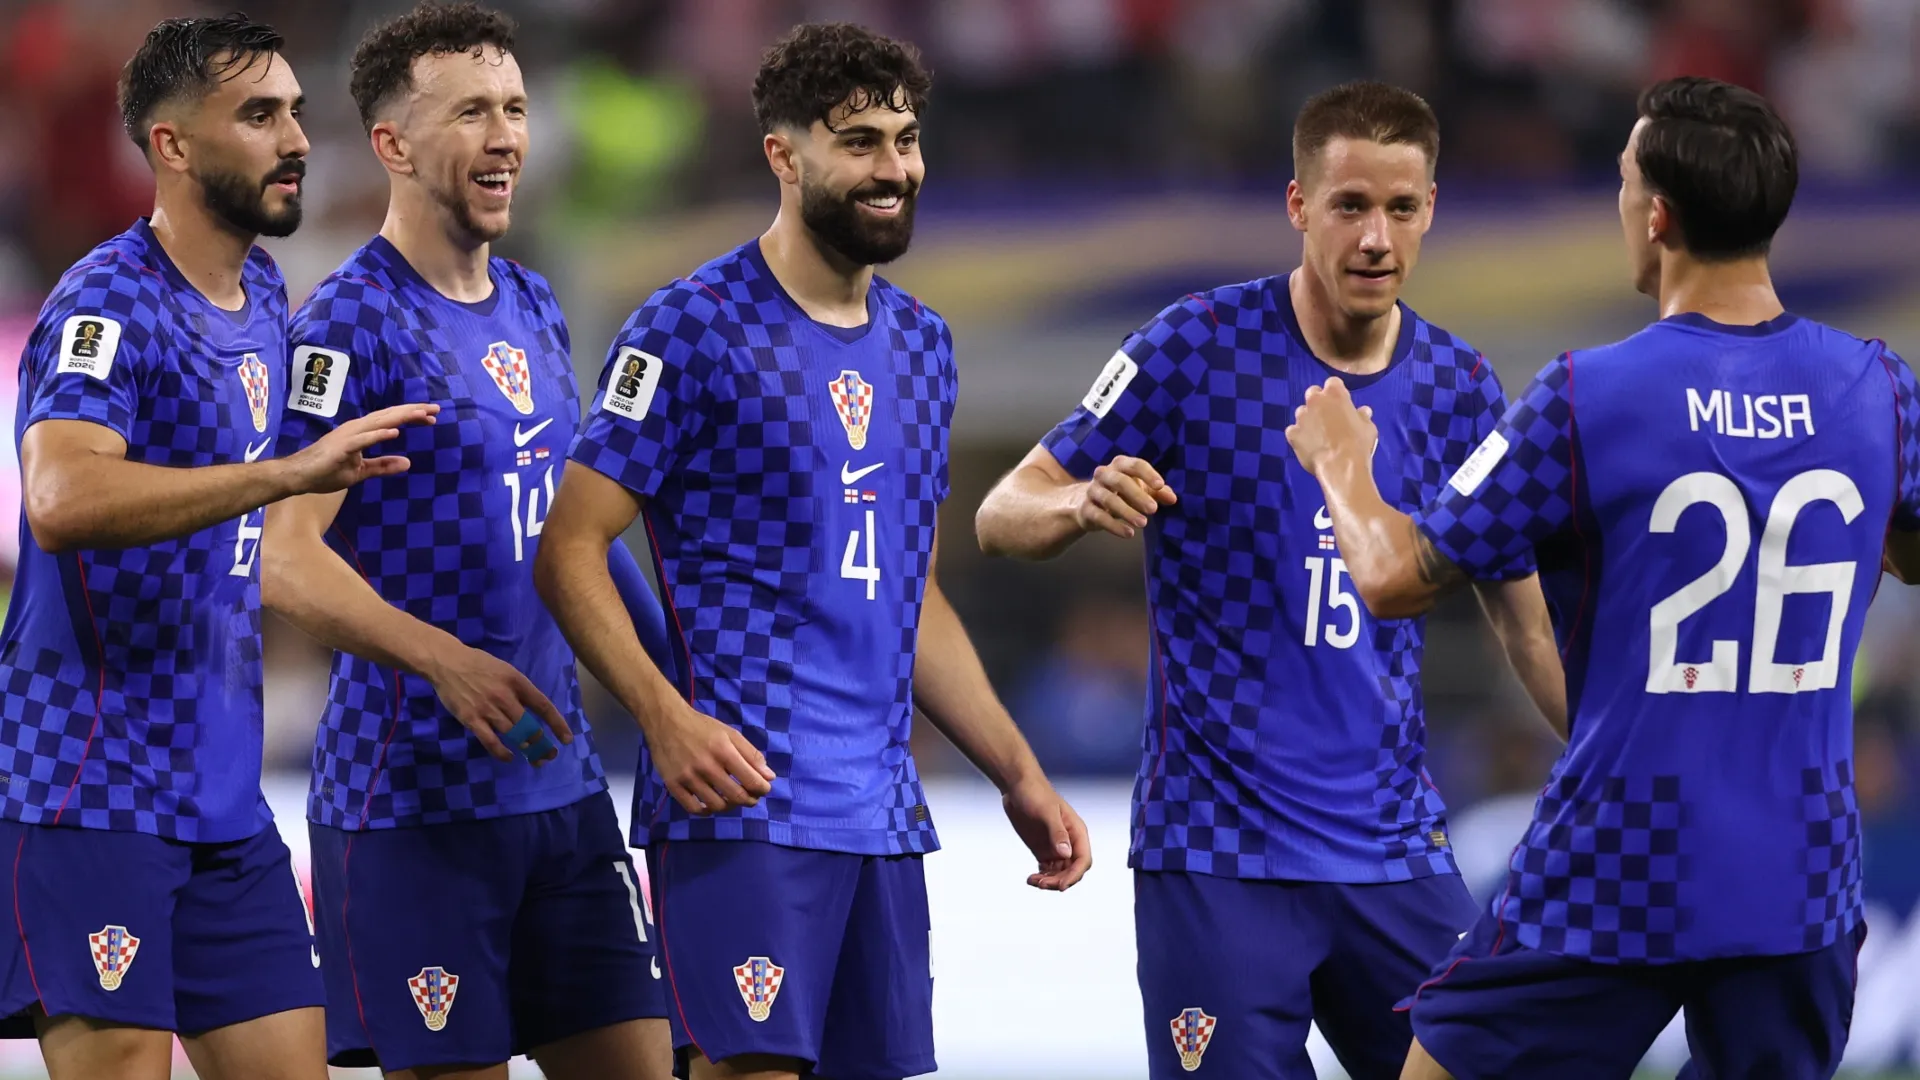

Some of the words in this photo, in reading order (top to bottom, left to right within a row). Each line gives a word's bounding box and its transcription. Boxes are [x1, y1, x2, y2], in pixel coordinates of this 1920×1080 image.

[67, 361, 95, 371] 2026
[297, 398, 323, 410] 2026
[609, 398, 633, 413] 2026
[1686, 388, 1815, 439] MUSA
[503, 464, 555, 562] 14
[841, 510, 880, 600] 4
[1645, 469, 1865, 694] 26
[1304, 556, 1360, 649] 15
